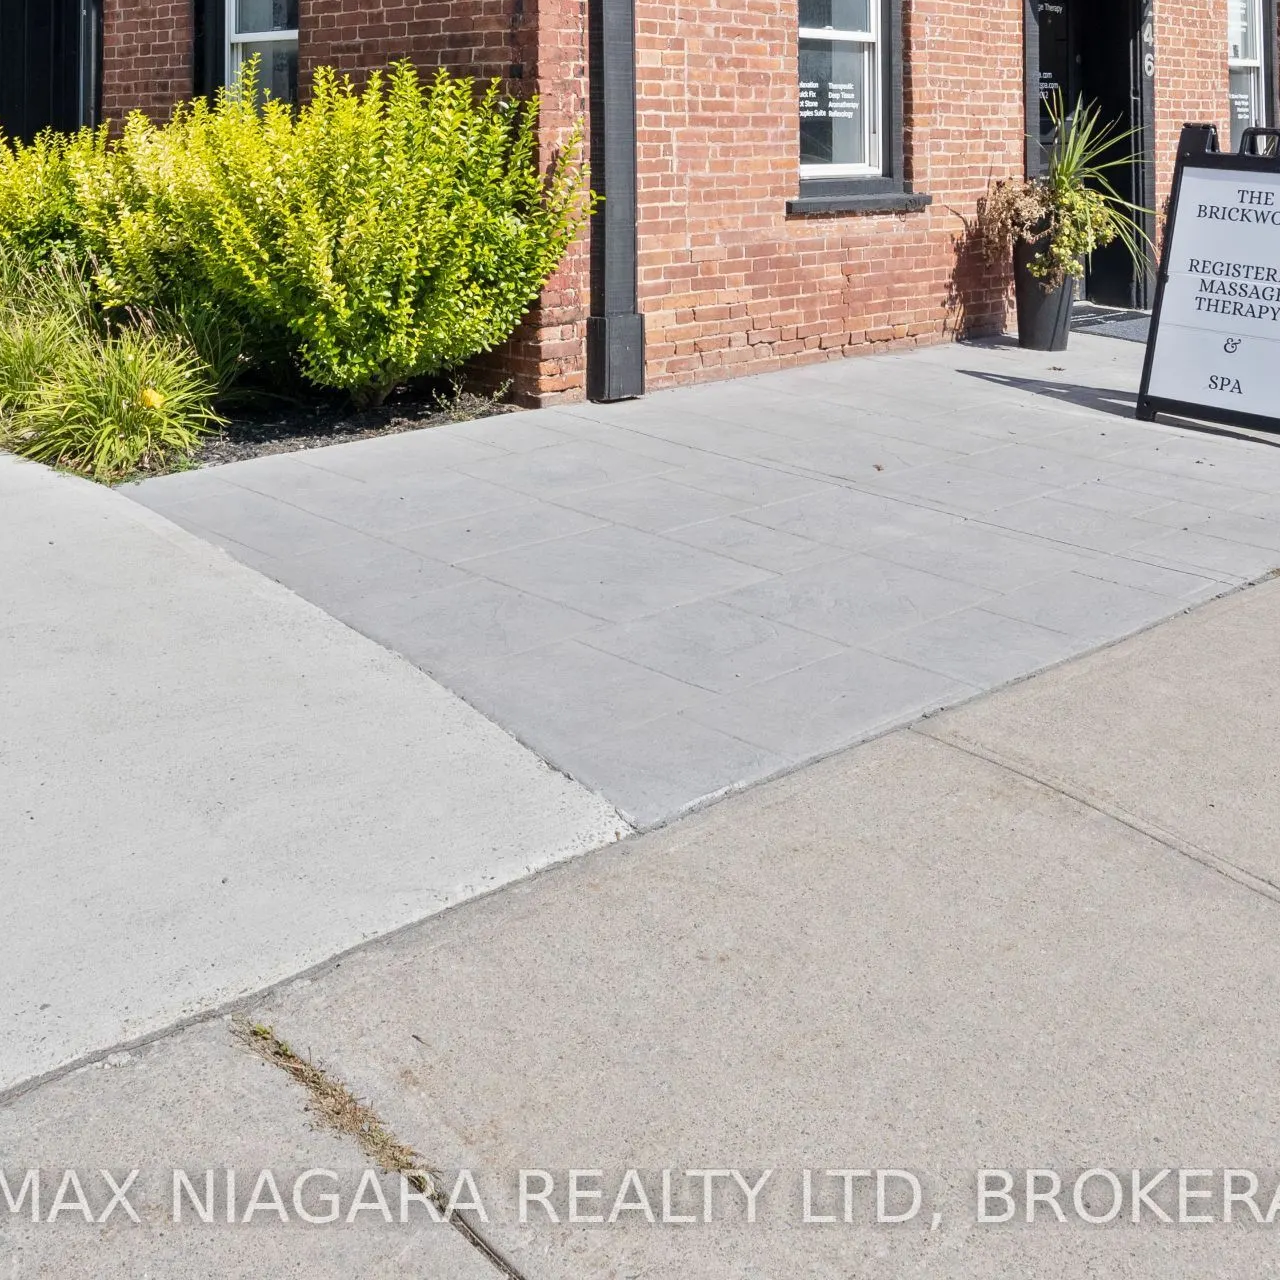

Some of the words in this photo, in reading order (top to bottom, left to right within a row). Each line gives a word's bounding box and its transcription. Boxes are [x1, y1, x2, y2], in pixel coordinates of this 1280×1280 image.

[1237, 189, 1275, 206] THE
[1224, 337, 1241, 353] &
[1208, 375, 1243, 394] SPA
